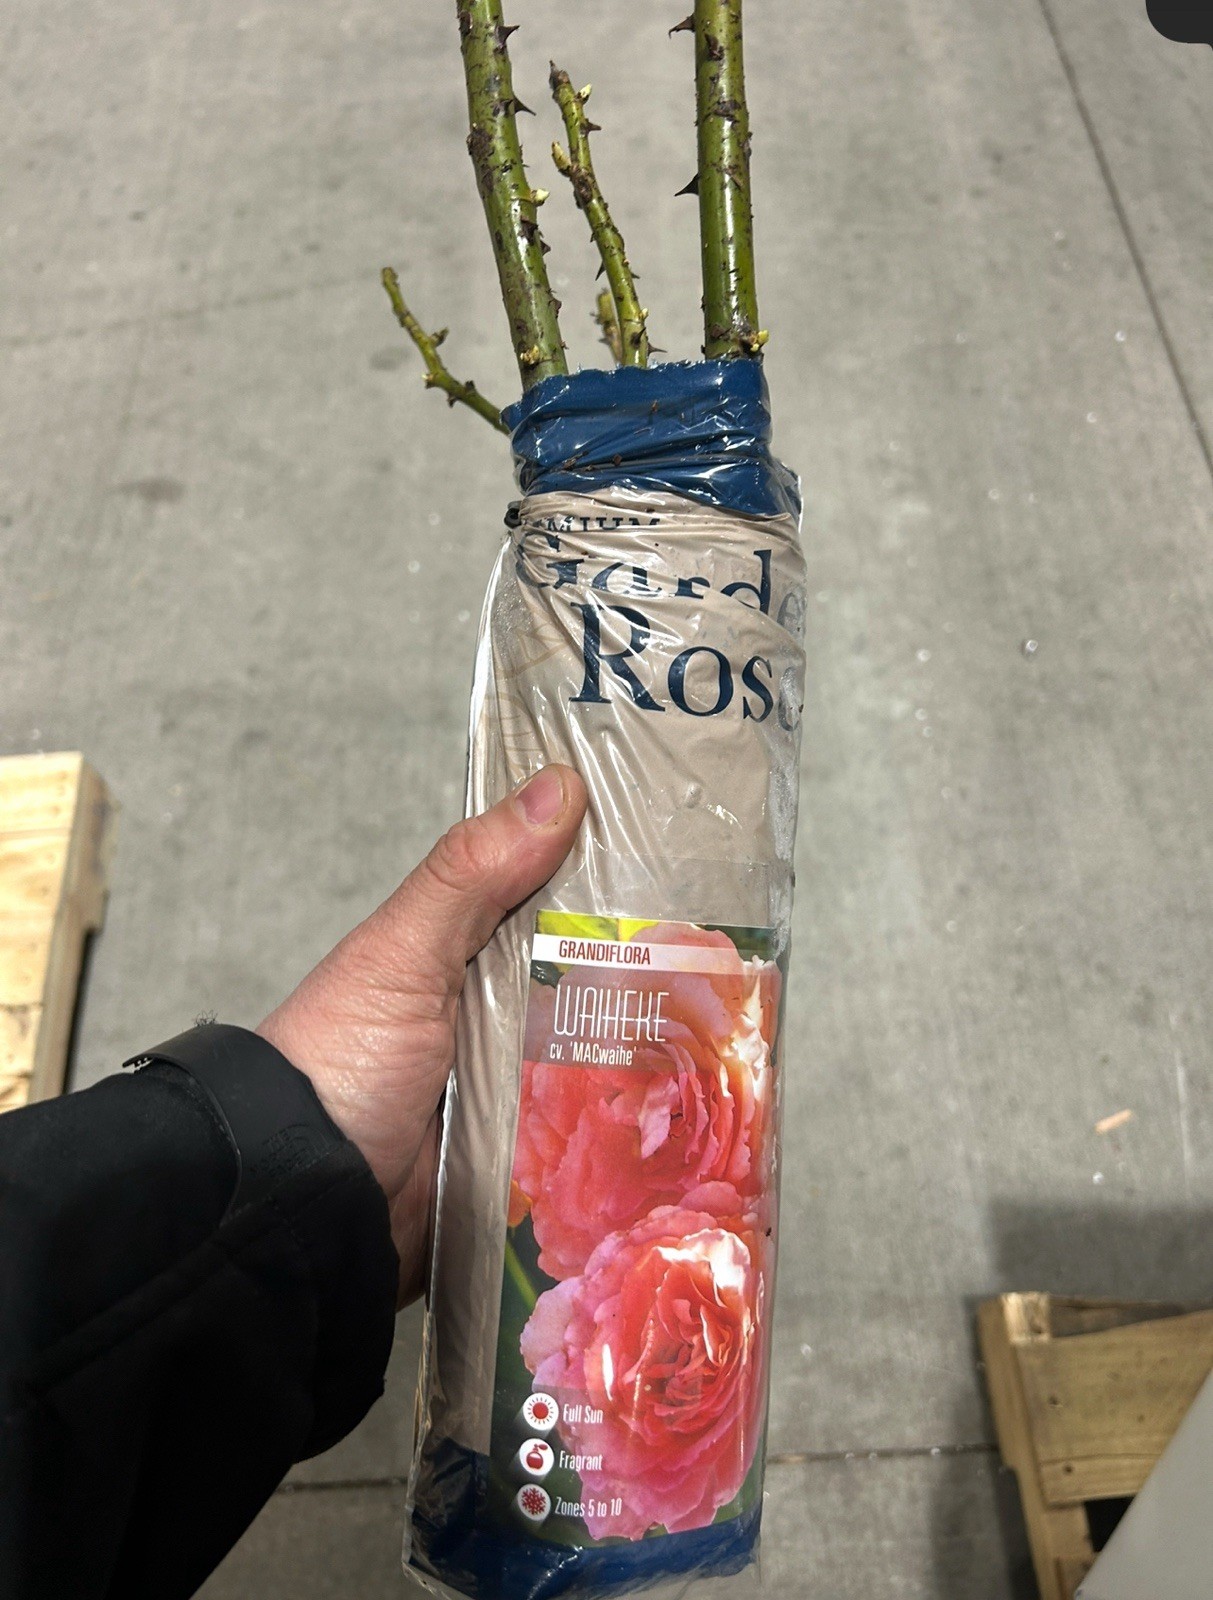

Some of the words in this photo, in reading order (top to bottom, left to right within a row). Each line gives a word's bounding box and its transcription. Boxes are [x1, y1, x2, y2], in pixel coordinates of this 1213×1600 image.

[558, 939, 651, 966] GRANDIFLORA
[553, 984, 670, 1042] WAIHEKE
[549, 1042, 565, 1060] cv.
[570, 1041, 637, 1066] 'MACwaihe'
[562, 1403, 583, 1424] Full
[584, 1405, 604, 1424] Sun
[559, 1450, 603, 1472] Fragrant
[554, 1496, 585, 1517] Zones
[587, 1498, 595, 1517] 5
[597, 1499, 608, 1516] to
[610, 1497, 622, 1516] 10
